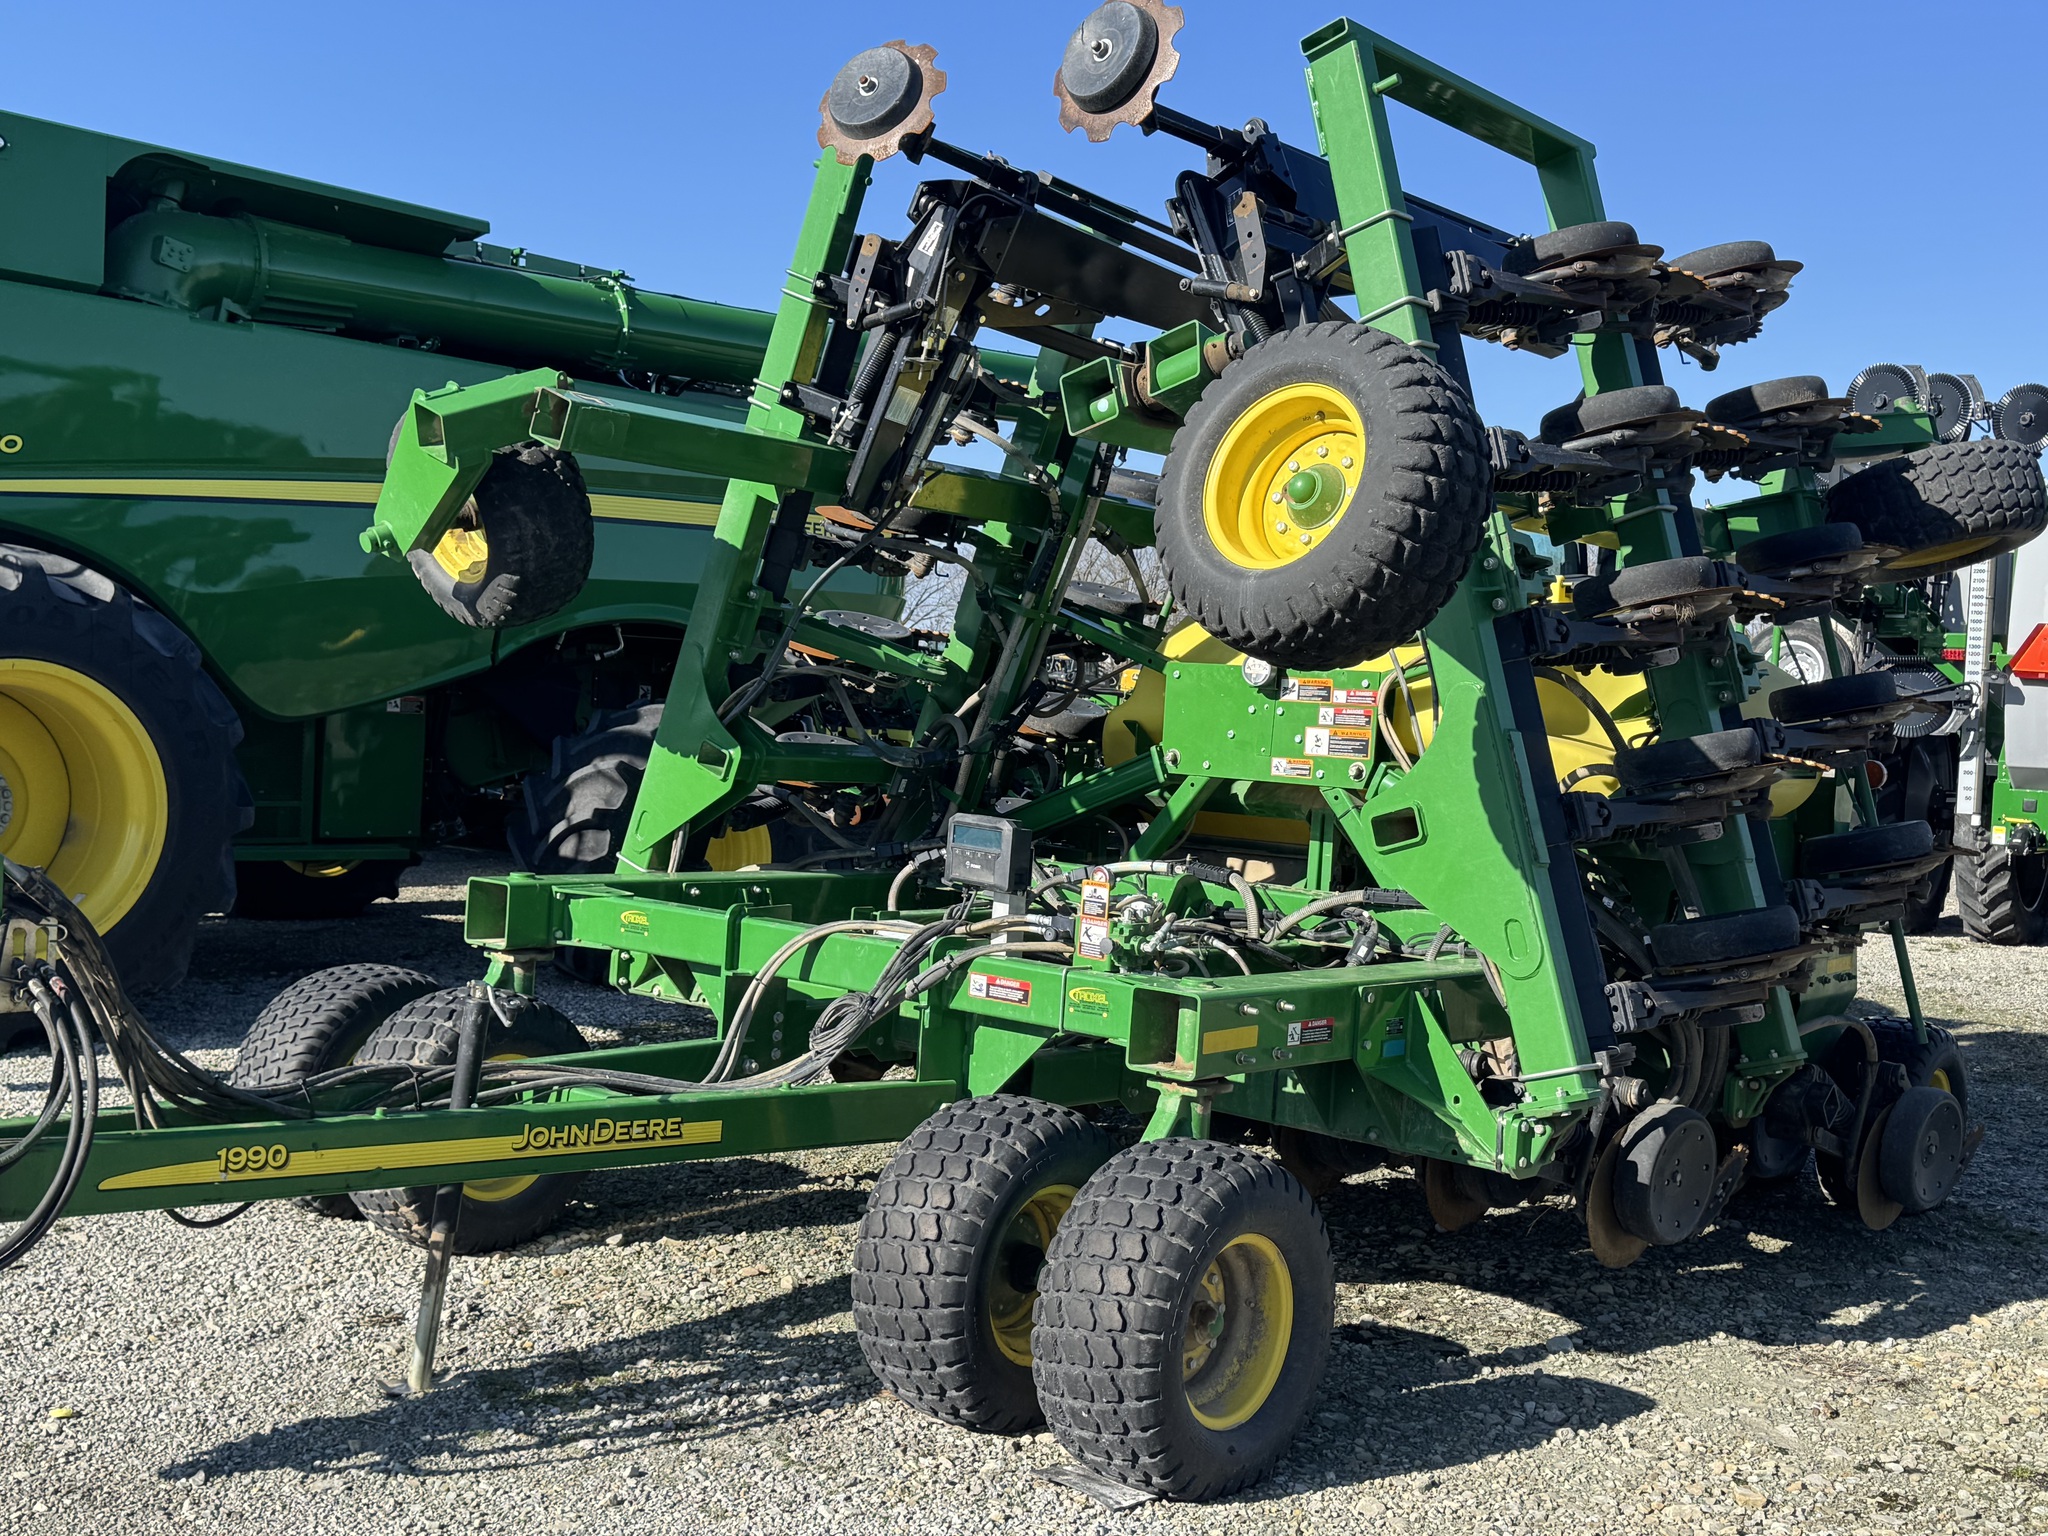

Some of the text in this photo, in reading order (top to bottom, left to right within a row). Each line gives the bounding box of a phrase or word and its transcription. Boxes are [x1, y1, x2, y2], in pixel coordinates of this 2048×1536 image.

[1086, 918, 1108, 927] DANGER
[1000, 979, 1020, 988] DANGER
[1312, 1019, 1327, 1027] DANGER
[512, 1117, 682, 1149] JOHN DEERE
[217, 1144, 288, 1172] 1990
